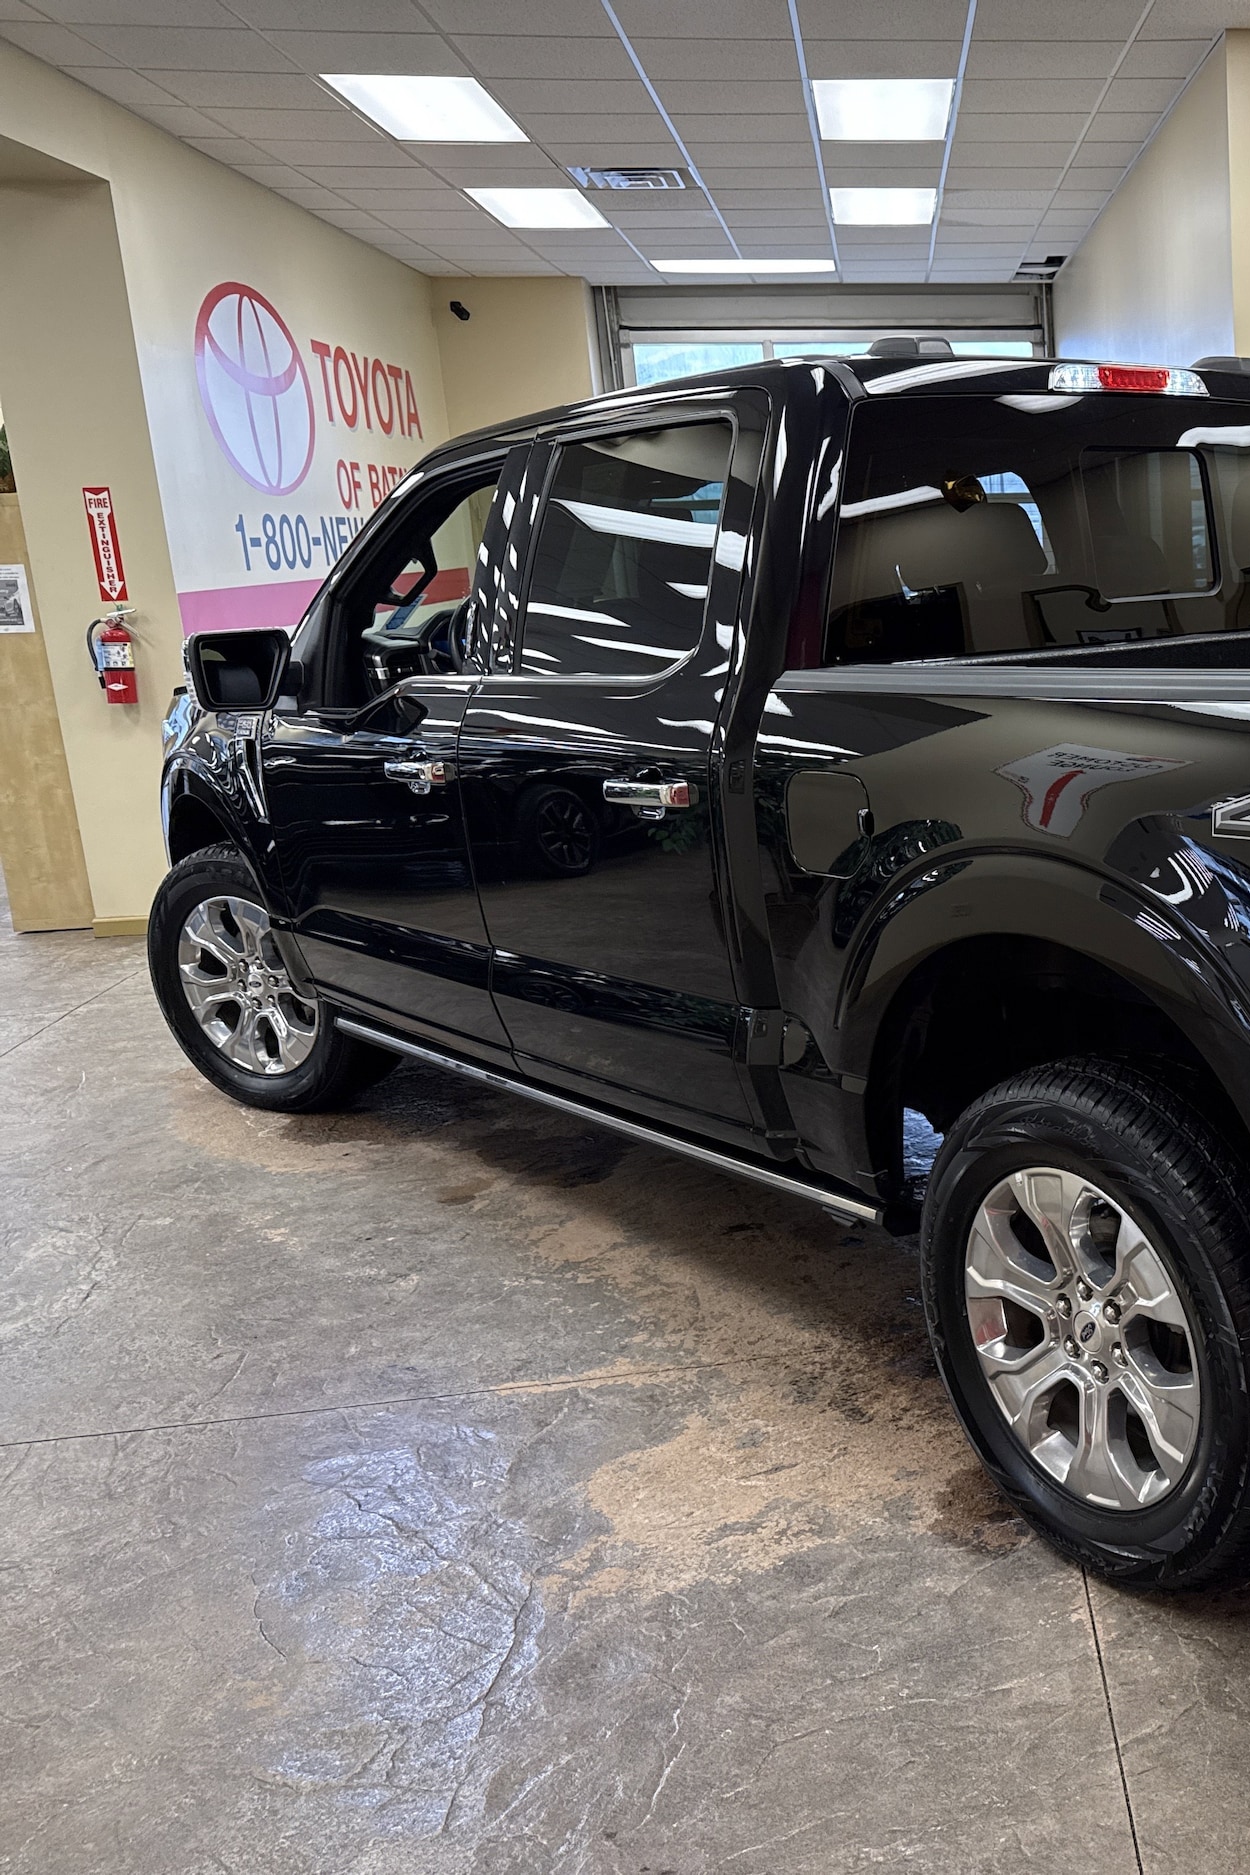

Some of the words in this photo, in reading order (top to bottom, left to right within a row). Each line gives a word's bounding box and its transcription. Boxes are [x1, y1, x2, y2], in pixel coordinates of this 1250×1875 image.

[310, 339, 424, 440] TOYOTA
[88, 498, 109, 509] FIRE
[336, 458, 363, 510] OF
[367, 463, 408, 509] BAT
[97, 512, 118, 593] EXTINGUISHER
